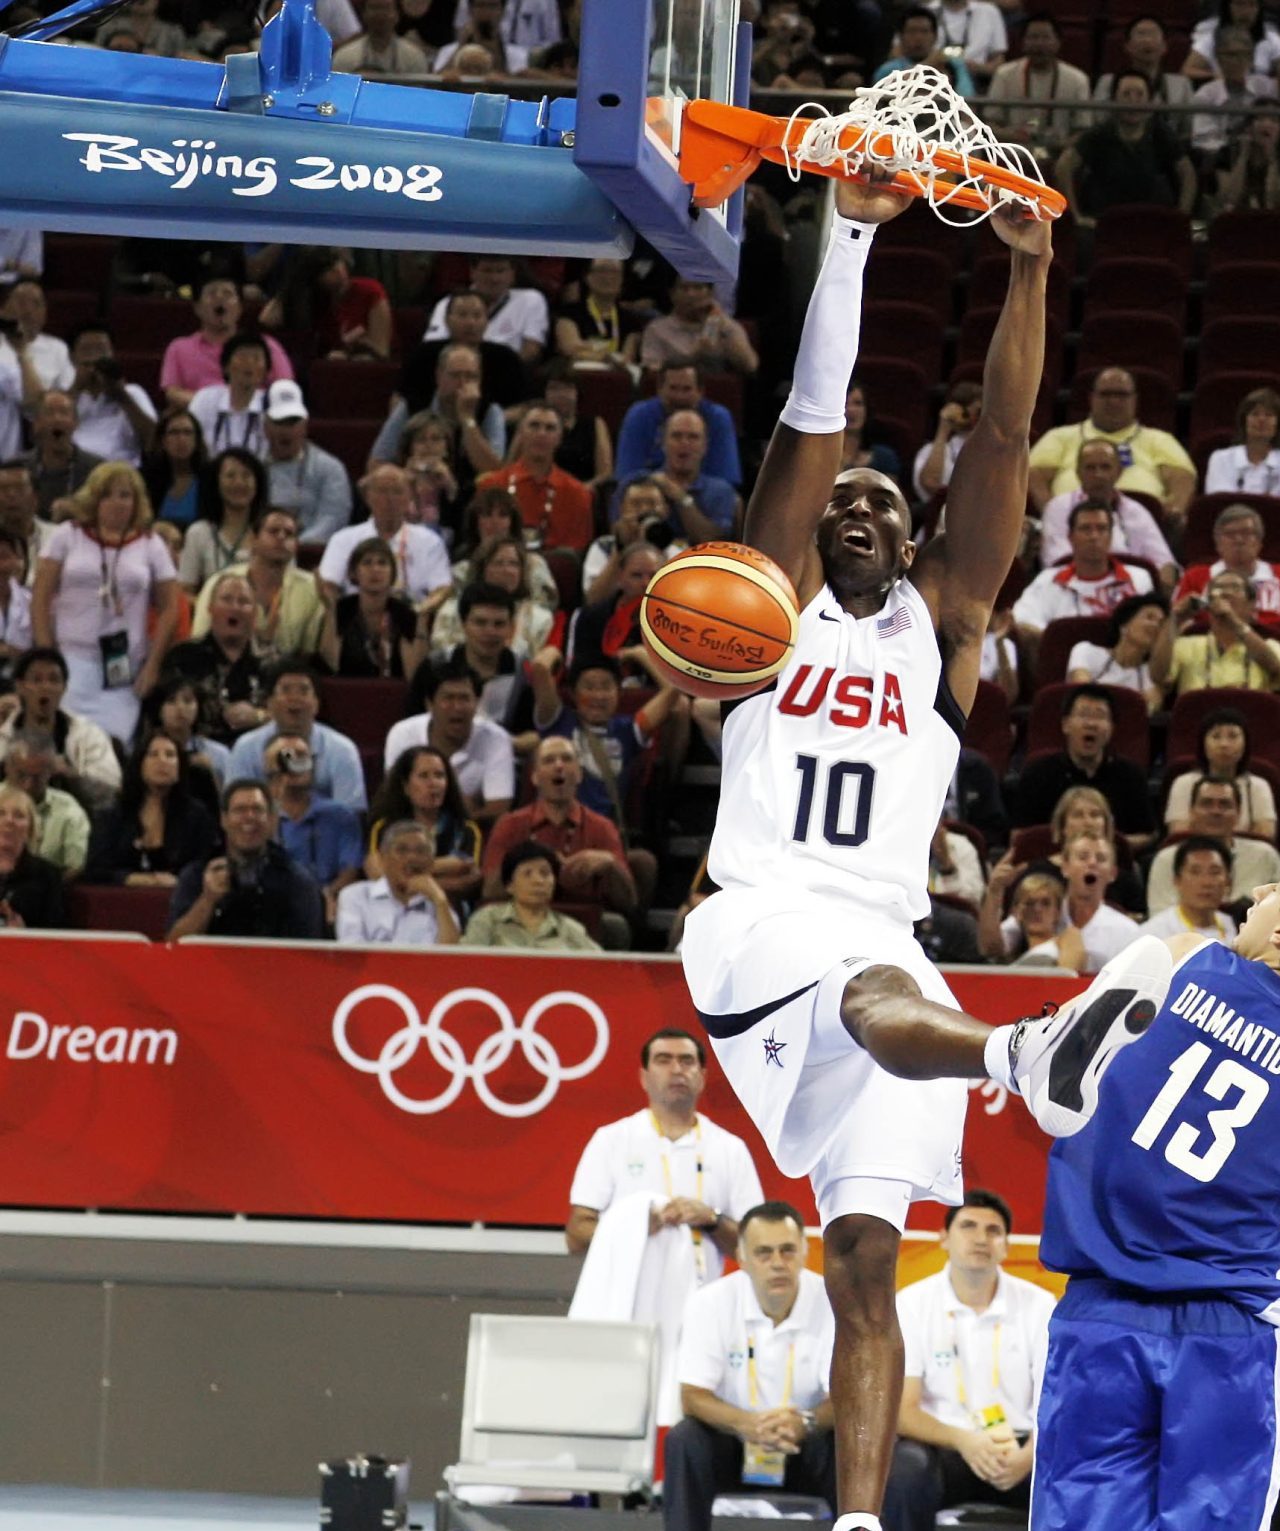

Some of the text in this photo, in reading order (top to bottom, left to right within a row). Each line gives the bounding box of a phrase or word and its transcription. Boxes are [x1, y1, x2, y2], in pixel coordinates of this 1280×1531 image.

[62, 132, 443, 202] Beijing 2008
[653, 607, 767, 665] Beijing 2008
[777, 664, 909, 736] USA
[792, 751, 878, 850] 10
[6, 1011, 179, 1065] Dream
[1131, 1040, 1270, 1183] 13
